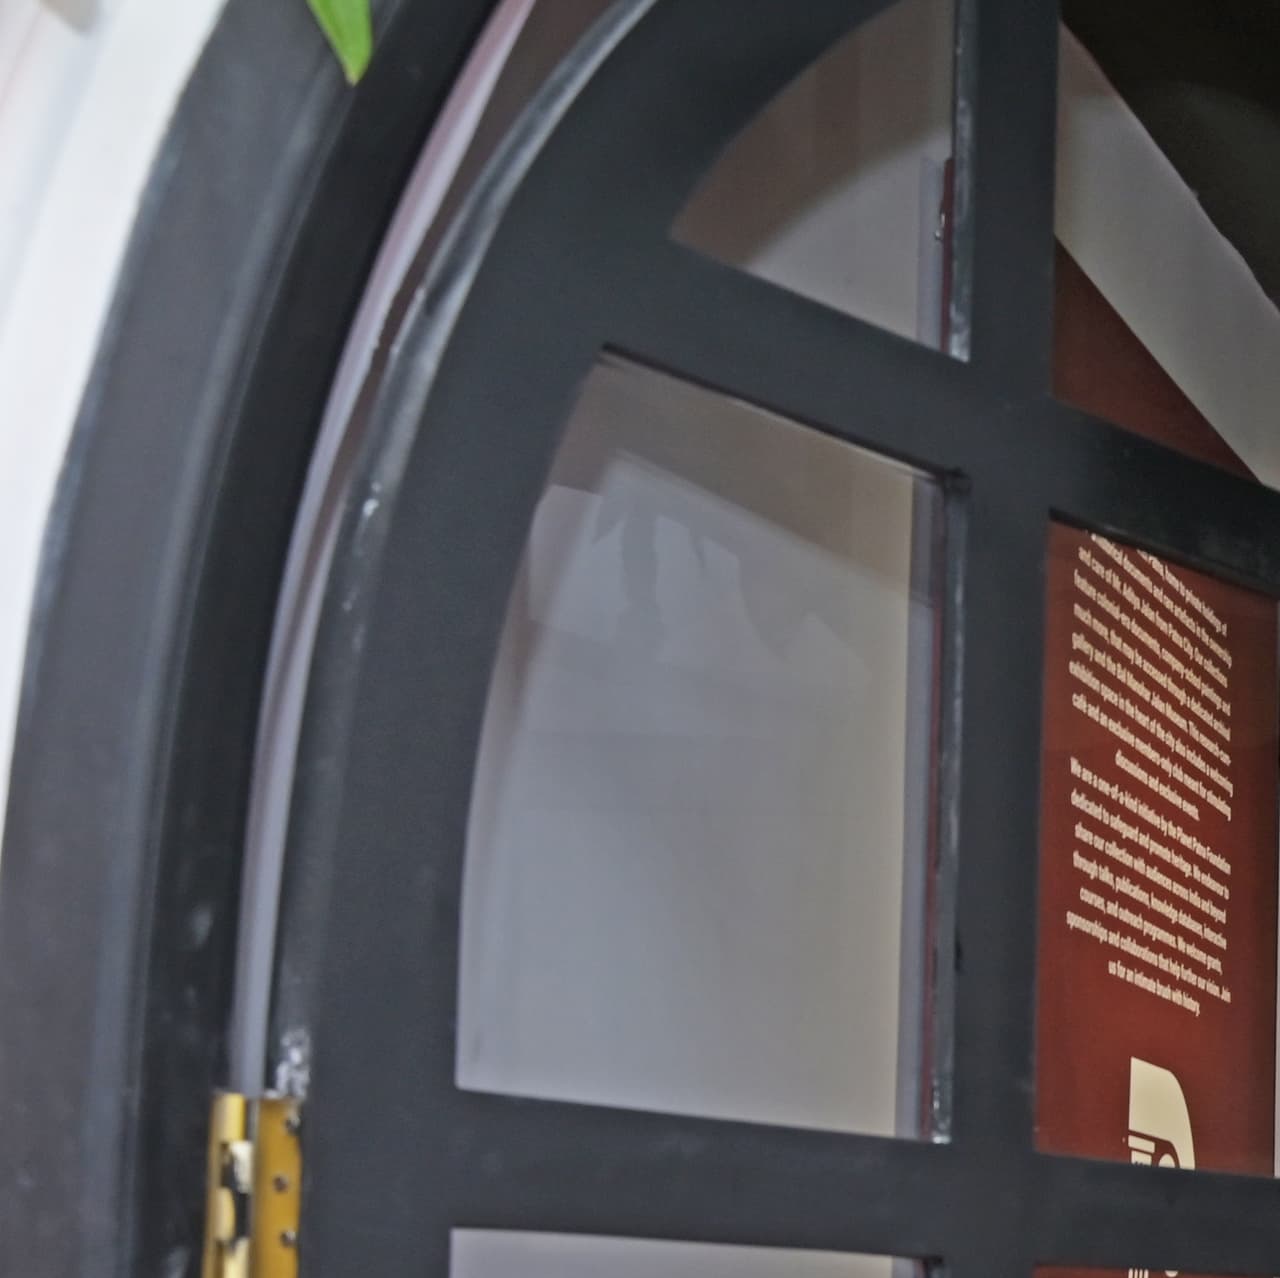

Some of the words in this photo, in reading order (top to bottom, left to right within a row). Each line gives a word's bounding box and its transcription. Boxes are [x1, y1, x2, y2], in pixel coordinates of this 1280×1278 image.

[1074, 569, 1097, 602] feature
[1097, 592, 1131, 630] colonial-era
[1131, 619, 1162, 658] documents,
[1202, 683, 1223, 710] paintings
[1222, 701, 1231, 716] and
[1079, 547, 1091, 566] and
[1092, 558, 1105, 578] care
[1105, 569, 1112, 584] of
[1122, 583, 1140, 610] Aditya
[1140, 600, 1155, 623] Jalan
[1155, 611, 1168, 635] from
[1168, 623, 1184, 648] Patna
[1194, 648, 1204, 667] Our
[1204, 659, 1228, 688] collections
[1123, 555, 1153, 594] documents
[1153, 585, 1163, 603] and
[1164, 595, 1174, 613] rare
[1200, 628, 1209, 646] the
[1072, 633, 1093, 661] gallery
[1094, 649, 1105, 667] and
[1106, 656, 1116, 675] the
[1116, 663, 1127, 683] Bal
[1127, 672, 1151, 703] Manohar
[1152, 692, 1166, 715] Jalan
[1166, 703, 1189, 733] Museum.
[1189, 720, 1200, 742] This
[1074, 604, 1092, 627] much
[1092, 618, 1109, 644] more,
[1110, 630, 1123, 653] that
[1122, 642, 1135, 664] may
[1135, 649, 1143, 667] be
[1143, 660, 1168, 688] accessed
[1168, 678, 1187, 706] through
[1190, 697, 1214, 728] dedicated
[1069, 661, 1100, 693] exhibition
[1101, 684, 1119, 707] space
[1125, 699, 1135, 718] the
[1135, 705, 1150, 730] heart
[1150, 719, 1157, 736] of
[1156, 723, 1165, 741] the
[1165, 731, 1175, 752] city
[1175, 739, 1187, 759] also
[1186, 746, 1207, 775] includes
[1210, 768, 1233, 797] welcoming
[1088, 704, 1100, 723] and
[1100, 713, 1109, 729] an
[1108, 719, 1135, 747] exclusive
[1135, 738, 1173, 777] members-only
[1172, 764, 1184, 783] club
[1184, 774, 1201, 795] meant
[1200, 782, 1208, 801] for
[1207, 791, 1231, 821] stimulating
[1071, 757, 1082, 779] We
[1082, 768, 1094, 787] are
[1098, 778, 1139, 815] one-of-a-kind
[1138, 800, 1161, 829] initiative
[1161, 816, 1168, 836] by
[1168, 821, 1178, 840] the
[1178, 826, 1194, 851] Planet
[1194, 837, 1207, 859] Patna
[1207, 847, 1231, 874] Foundation
[1116, 750, 1149, 787] discussions
[1148, 776, 1159, 792] and
[1159, 783, 1183, 810] exclusive
[1182, 800, 1200, 821] events.
[1071, 789, 1103, 821] dedicated
[1103, 808, 1110, 825] to
[1110, 815, 1140, 844] safeguard
[1140, 833, 1151, 854] and
[1150, 840, 1172, 863] promote
[1172, 850, 1193, 877] heritage.
[1194, 864, 1201, 881] We
[1224, 886, 1229, 899] to
[1075, 823, 1093, 845] share
[1094, 835, 1105, 850] our
[1105, 842, 1134, 868] collection
[1134, 858, 1146, 876] with
[1146, 866, 1173, 892] audiences
[1172, 882, 1190, 902] across
[1190, 889, 1201, 908] India
[1201, 899, 1211, 915] and
[1210, 901, 1227, 923] beyond
[1073, 851, 1099, 879] through
[1099, 865, 1115, 889] talks,
[1115, 877, 1151, 909] publications,
[1150, 893, 1179, 923] knowledge
[1178, 910, 1204, 939] databases,
[1204, 924, 1227, 949] interactive
[1080, 888, 1107, 914] courses,
[1106, 901, 1119, 917] and
[1118, 907, 1144, 936] outreach
[1144, 921, 1177, 948] programmes.
[1177, 936, 1186, 952] We
[1186, 944, 1207, 964] welcome
[1207, 955, 1223, 975] grants,
[1067, 911, 1108, 942] sponsorships
[1108, 932, 1121, 948] and
[1120, 936, 1159, 966] collaborations
[1158, 954, 1169, 972] that
[1169, 959, 1181, 980] help
[1180, 964, 1198, 986] further
[1198, 977, 1207, 991] our
[1206, 979, 1221, 998] vision.
[1221, 987, 1231, 1003] Join
[1108, 961, 1117, 975] us
[1117, 961, 1127, 981] for
[1126, 969, 1135, 984] an
[1134, 969, 1157, 994] intimate
[1156, 980, 1172, 1000] brush
[1172, 989, 1183, 1006] with
[1182, 992, 1201, 1016] history.
